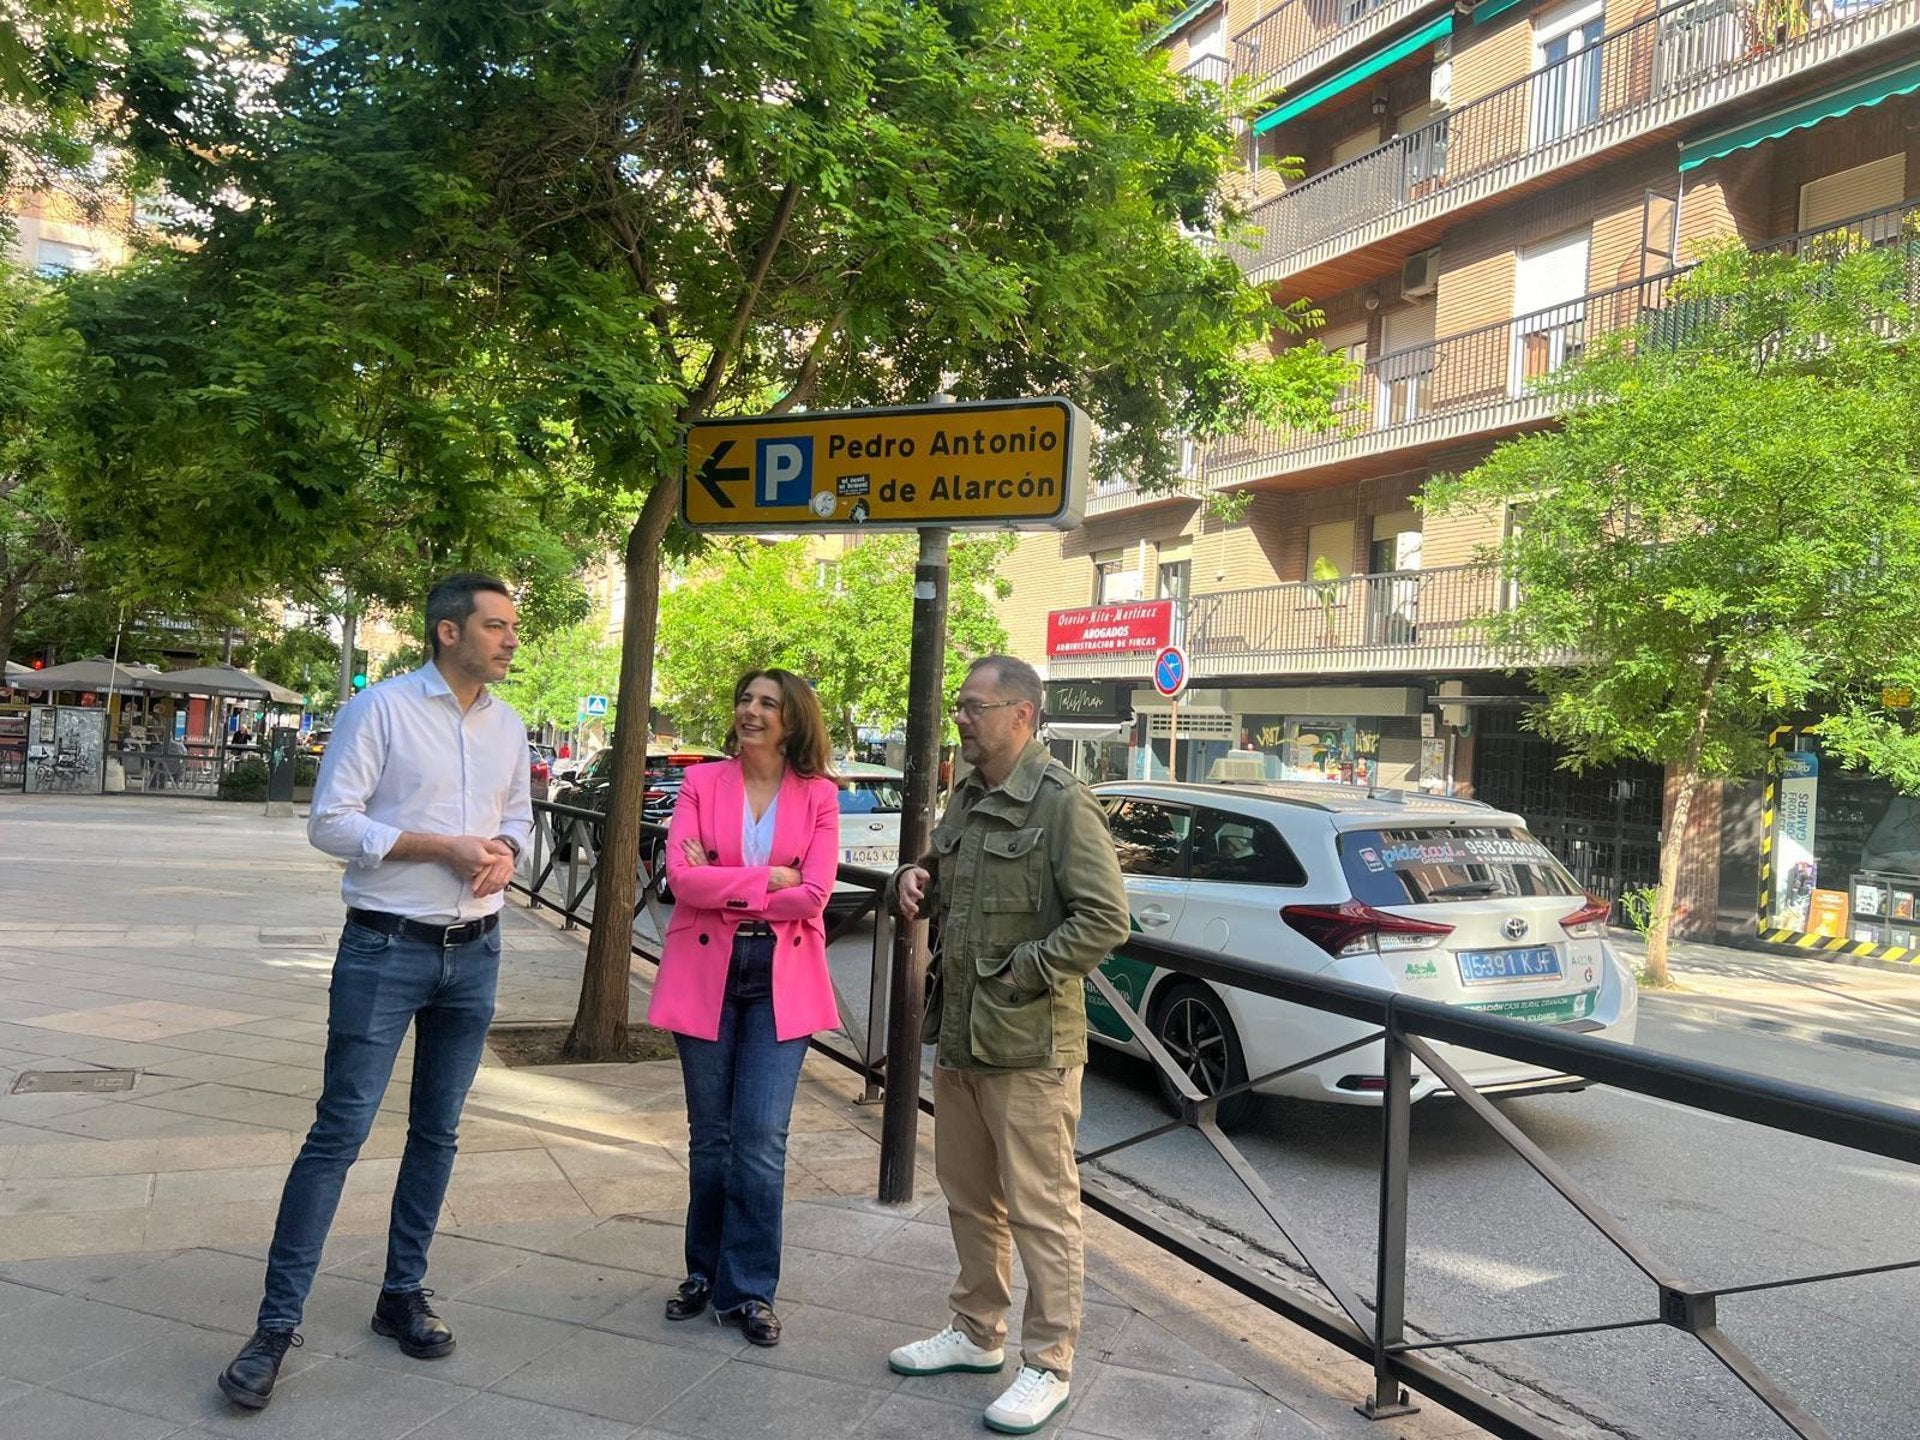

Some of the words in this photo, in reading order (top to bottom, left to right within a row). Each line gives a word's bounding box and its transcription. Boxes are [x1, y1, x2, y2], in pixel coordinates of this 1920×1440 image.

[829, 433, 915, 459] Pedro
[930, 426, 1057, 457] Antonio
[766, 444, 803, 501] P
[879, 478, 916, 503] de
[930, 471, 1055, 501] Alarcón
[1082, 626, 1130, 639] ABOGADOS
[1117, 639, 1126, 648] DE
[1128, 637, 1157, 646] FINCAS
[1796, 792, 1809, 841] GAMERS
[853, 851, 878, 861] 4043
[1472, 952, 1516, 976] 5391
[1521, 951, 1552, 973] KJF
